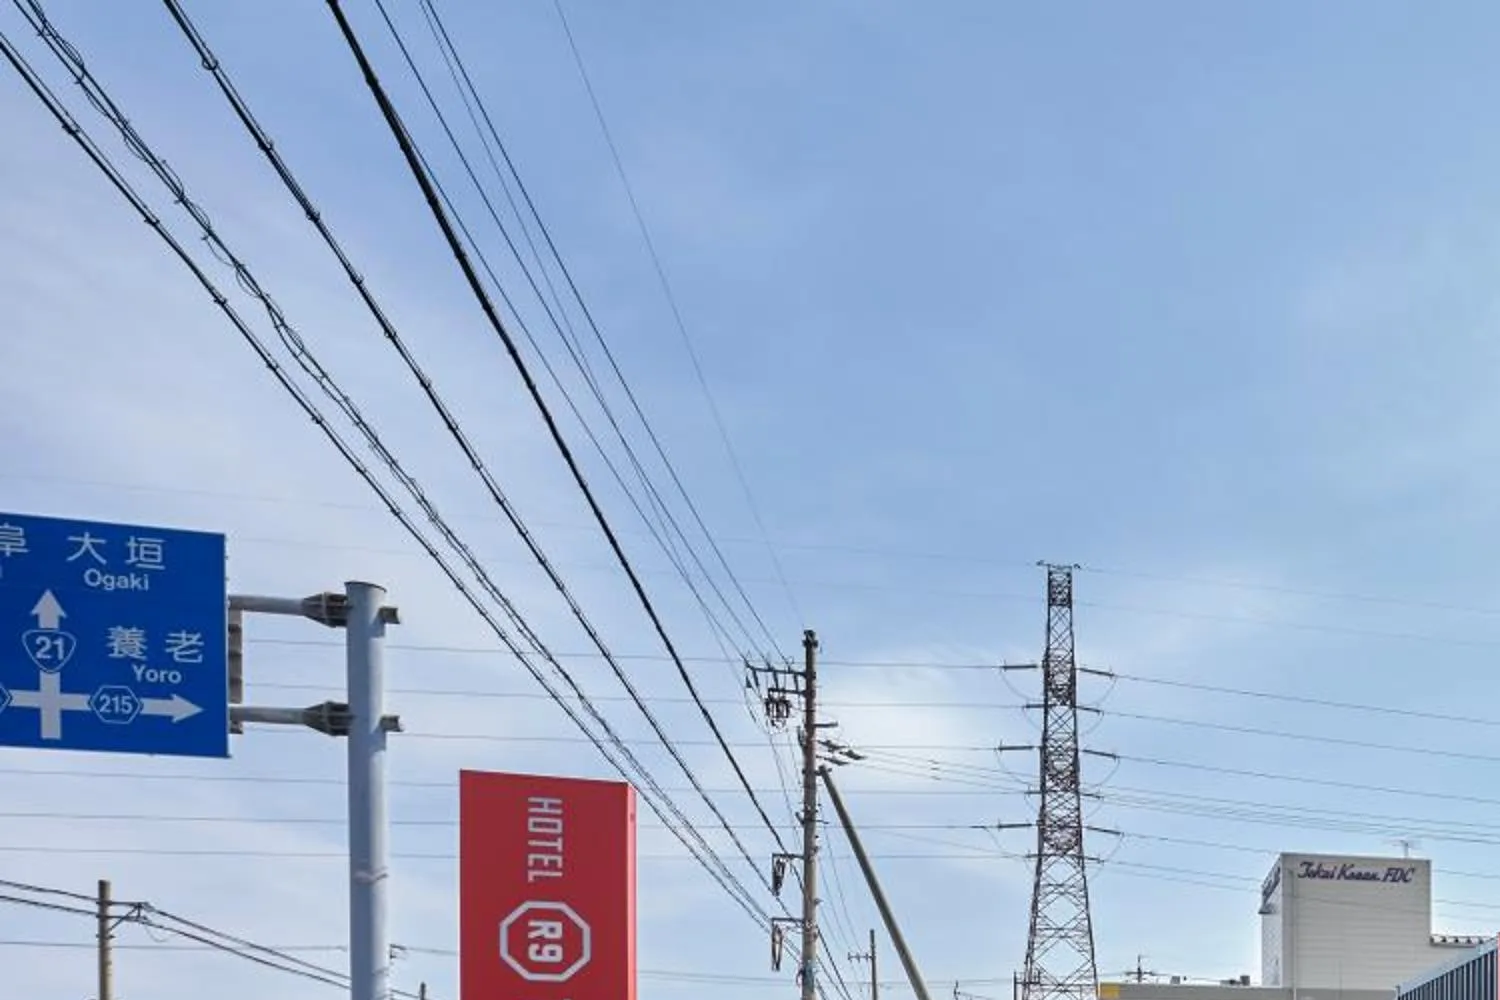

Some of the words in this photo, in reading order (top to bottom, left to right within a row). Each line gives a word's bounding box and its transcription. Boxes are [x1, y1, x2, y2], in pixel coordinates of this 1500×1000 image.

[66, 532, 165, 570] 大垣
[84, 568, 149, 591] Ogaki
[35, 636, 65, 660] 21
[106, 626, 204, 663] 養老
[133, 664, 182, 684] Yoro
[100, 694, 132, 713] 215
[527, 797, 563, 882] HOTEL
[528, 919, 563, 963] R9
